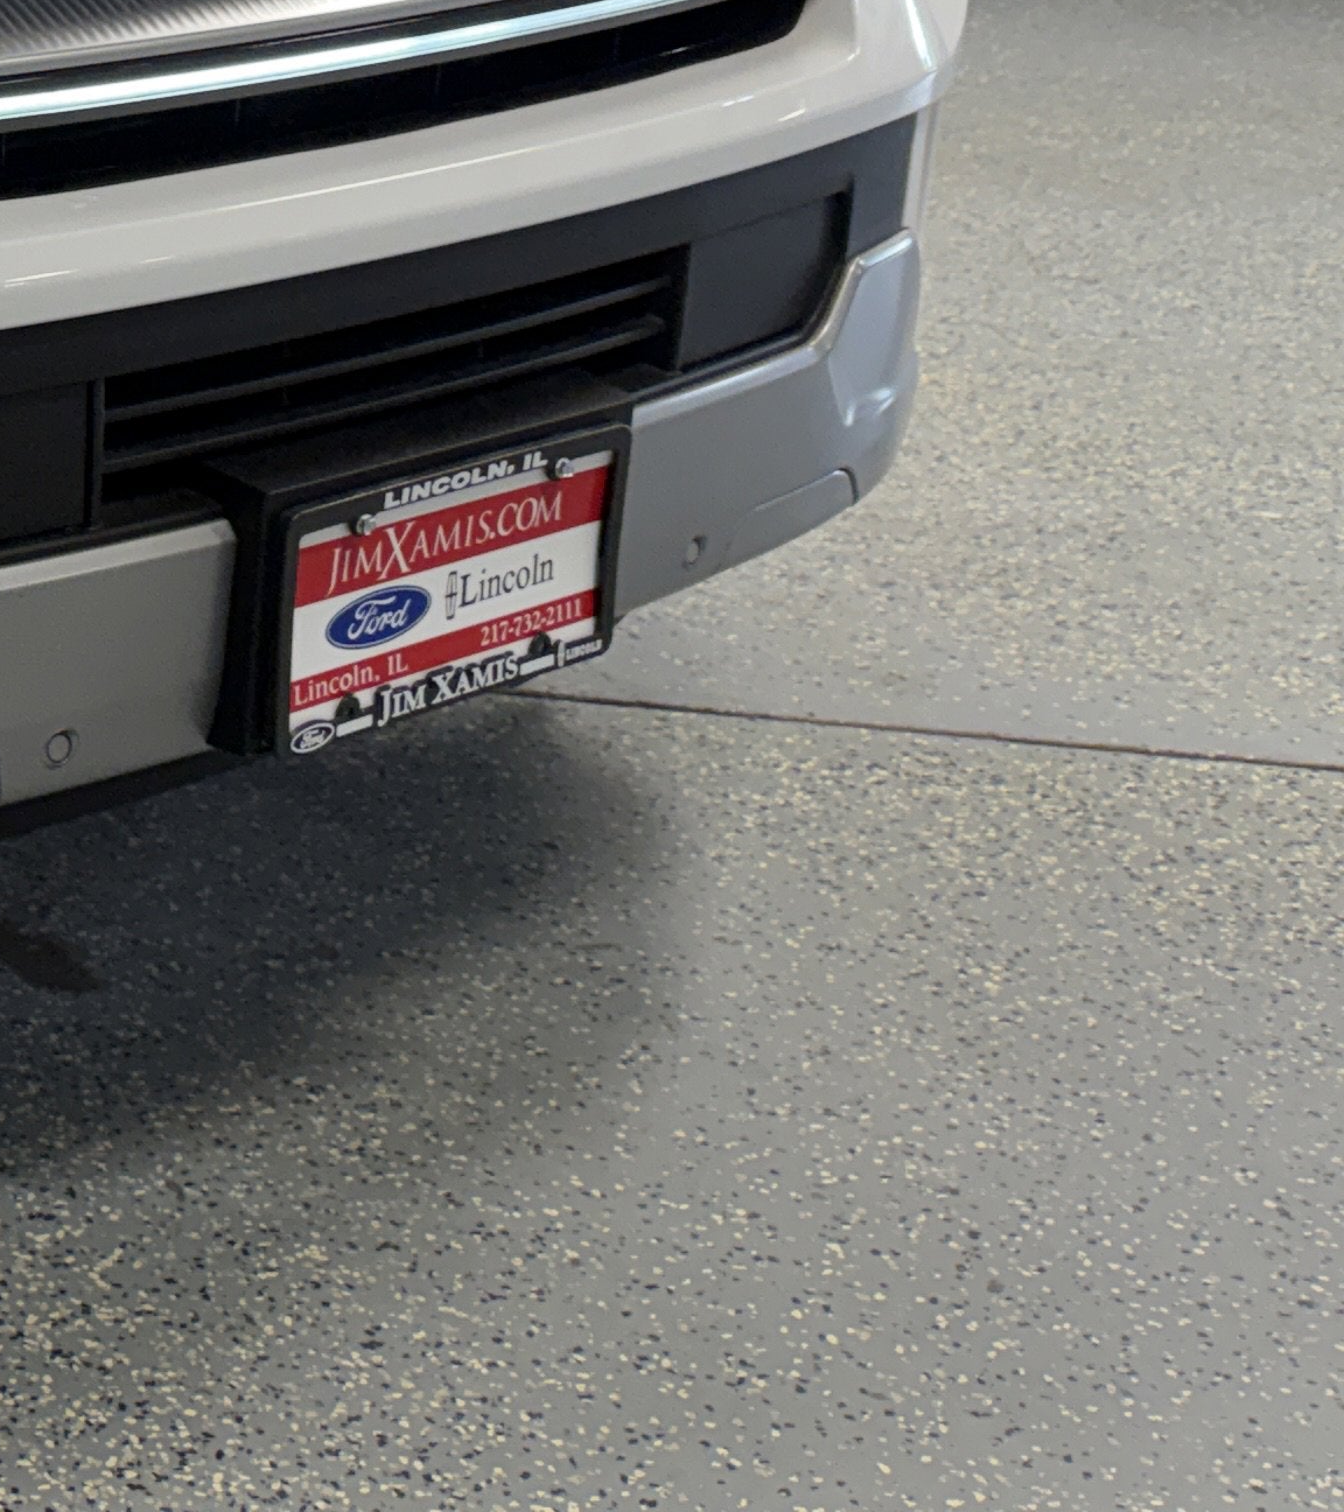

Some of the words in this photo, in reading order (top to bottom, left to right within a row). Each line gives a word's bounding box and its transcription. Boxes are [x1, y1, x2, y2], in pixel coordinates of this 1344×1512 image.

[522, 451, 548, 471] IL
[327, 490, 564, 596] JIMXAMIS.COM
[460, 553, 555, 609] Lincoln
[347, 597, 408, 640] Ford
[479, 598, 583, 647] 217-732-2111
[294, 661, 380, 706] Lincoln,
[387, 650, 409, 675] IL
[377, 689, 426, 727] JIM
[431, 654, 519, 704] XAMIS
